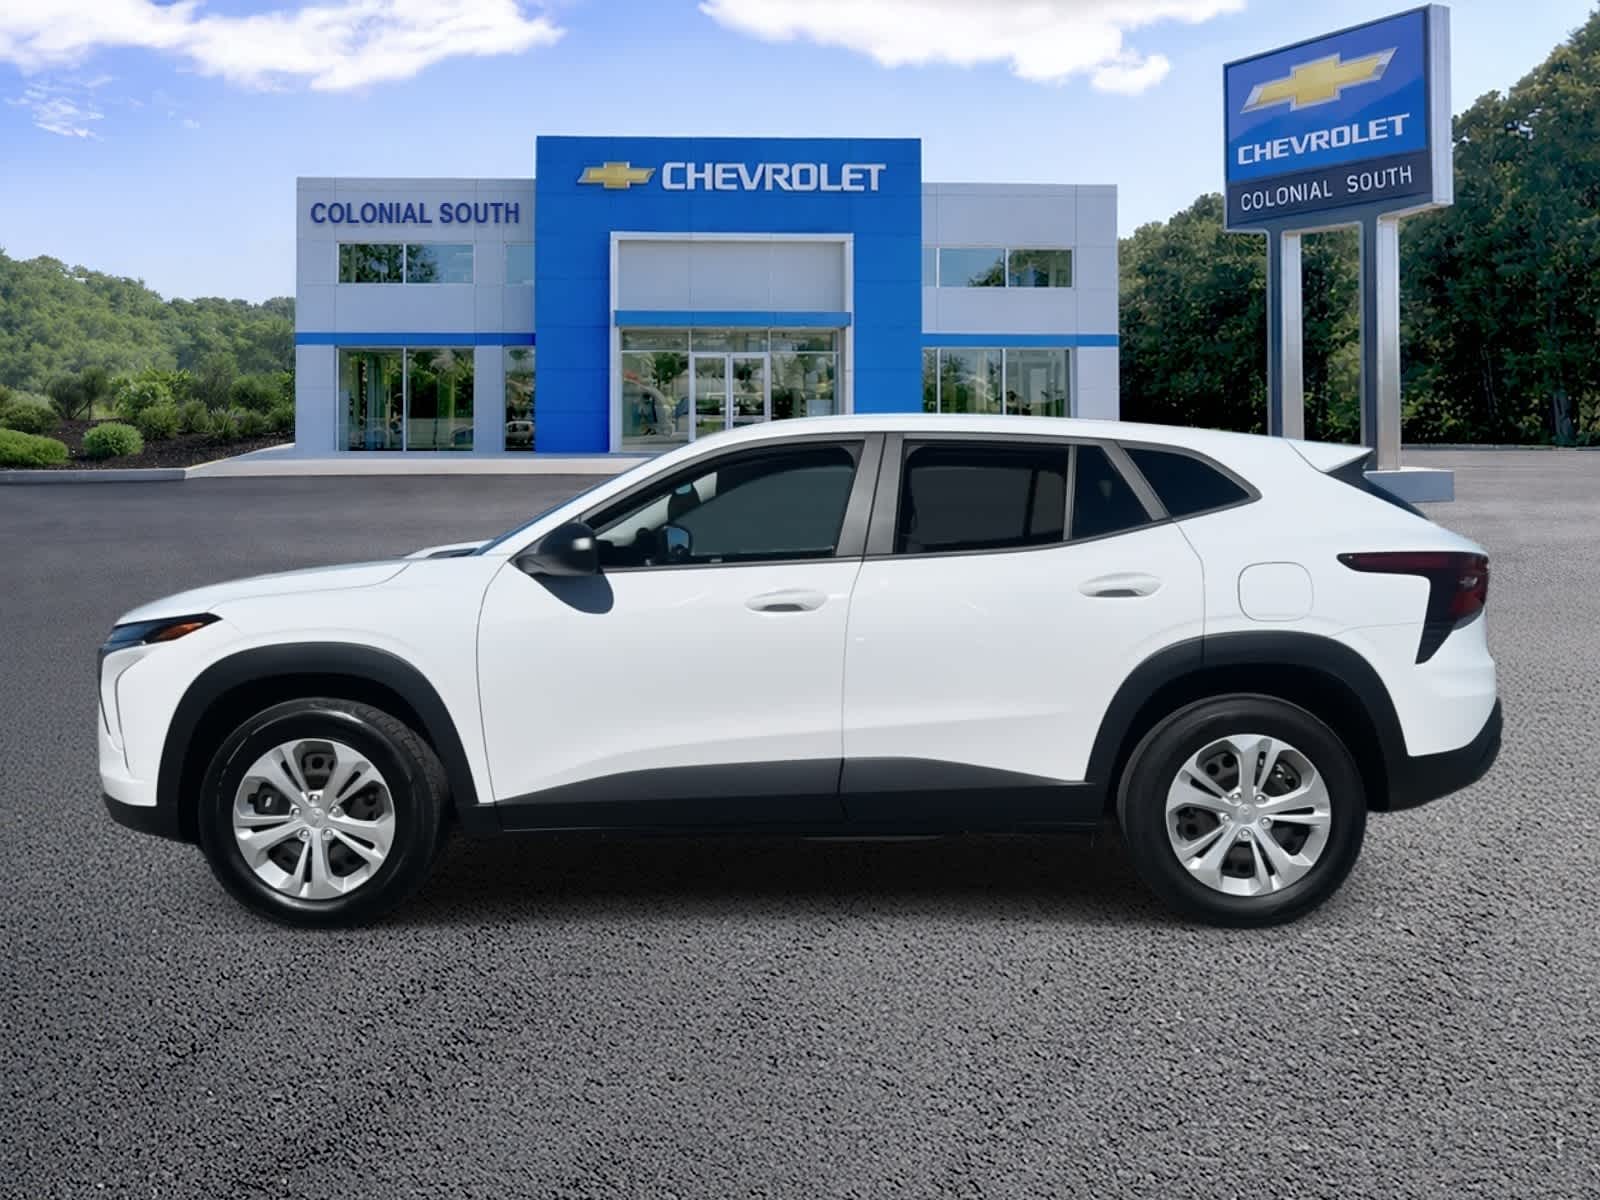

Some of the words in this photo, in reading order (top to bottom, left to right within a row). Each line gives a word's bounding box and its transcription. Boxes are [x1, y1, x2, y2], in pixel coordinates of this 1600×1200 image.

[1237, 113, 1410, 165] CHEVROLET
[662, 162, 886, 192] CHEVROLET
[1240, 179, 1333, 211] COLONIAL
[1346, 165, 1412, 193] SOUTH
[310, 202, 433, 225] COLONIAL
[438, 202, 521, 225] SOUTH
